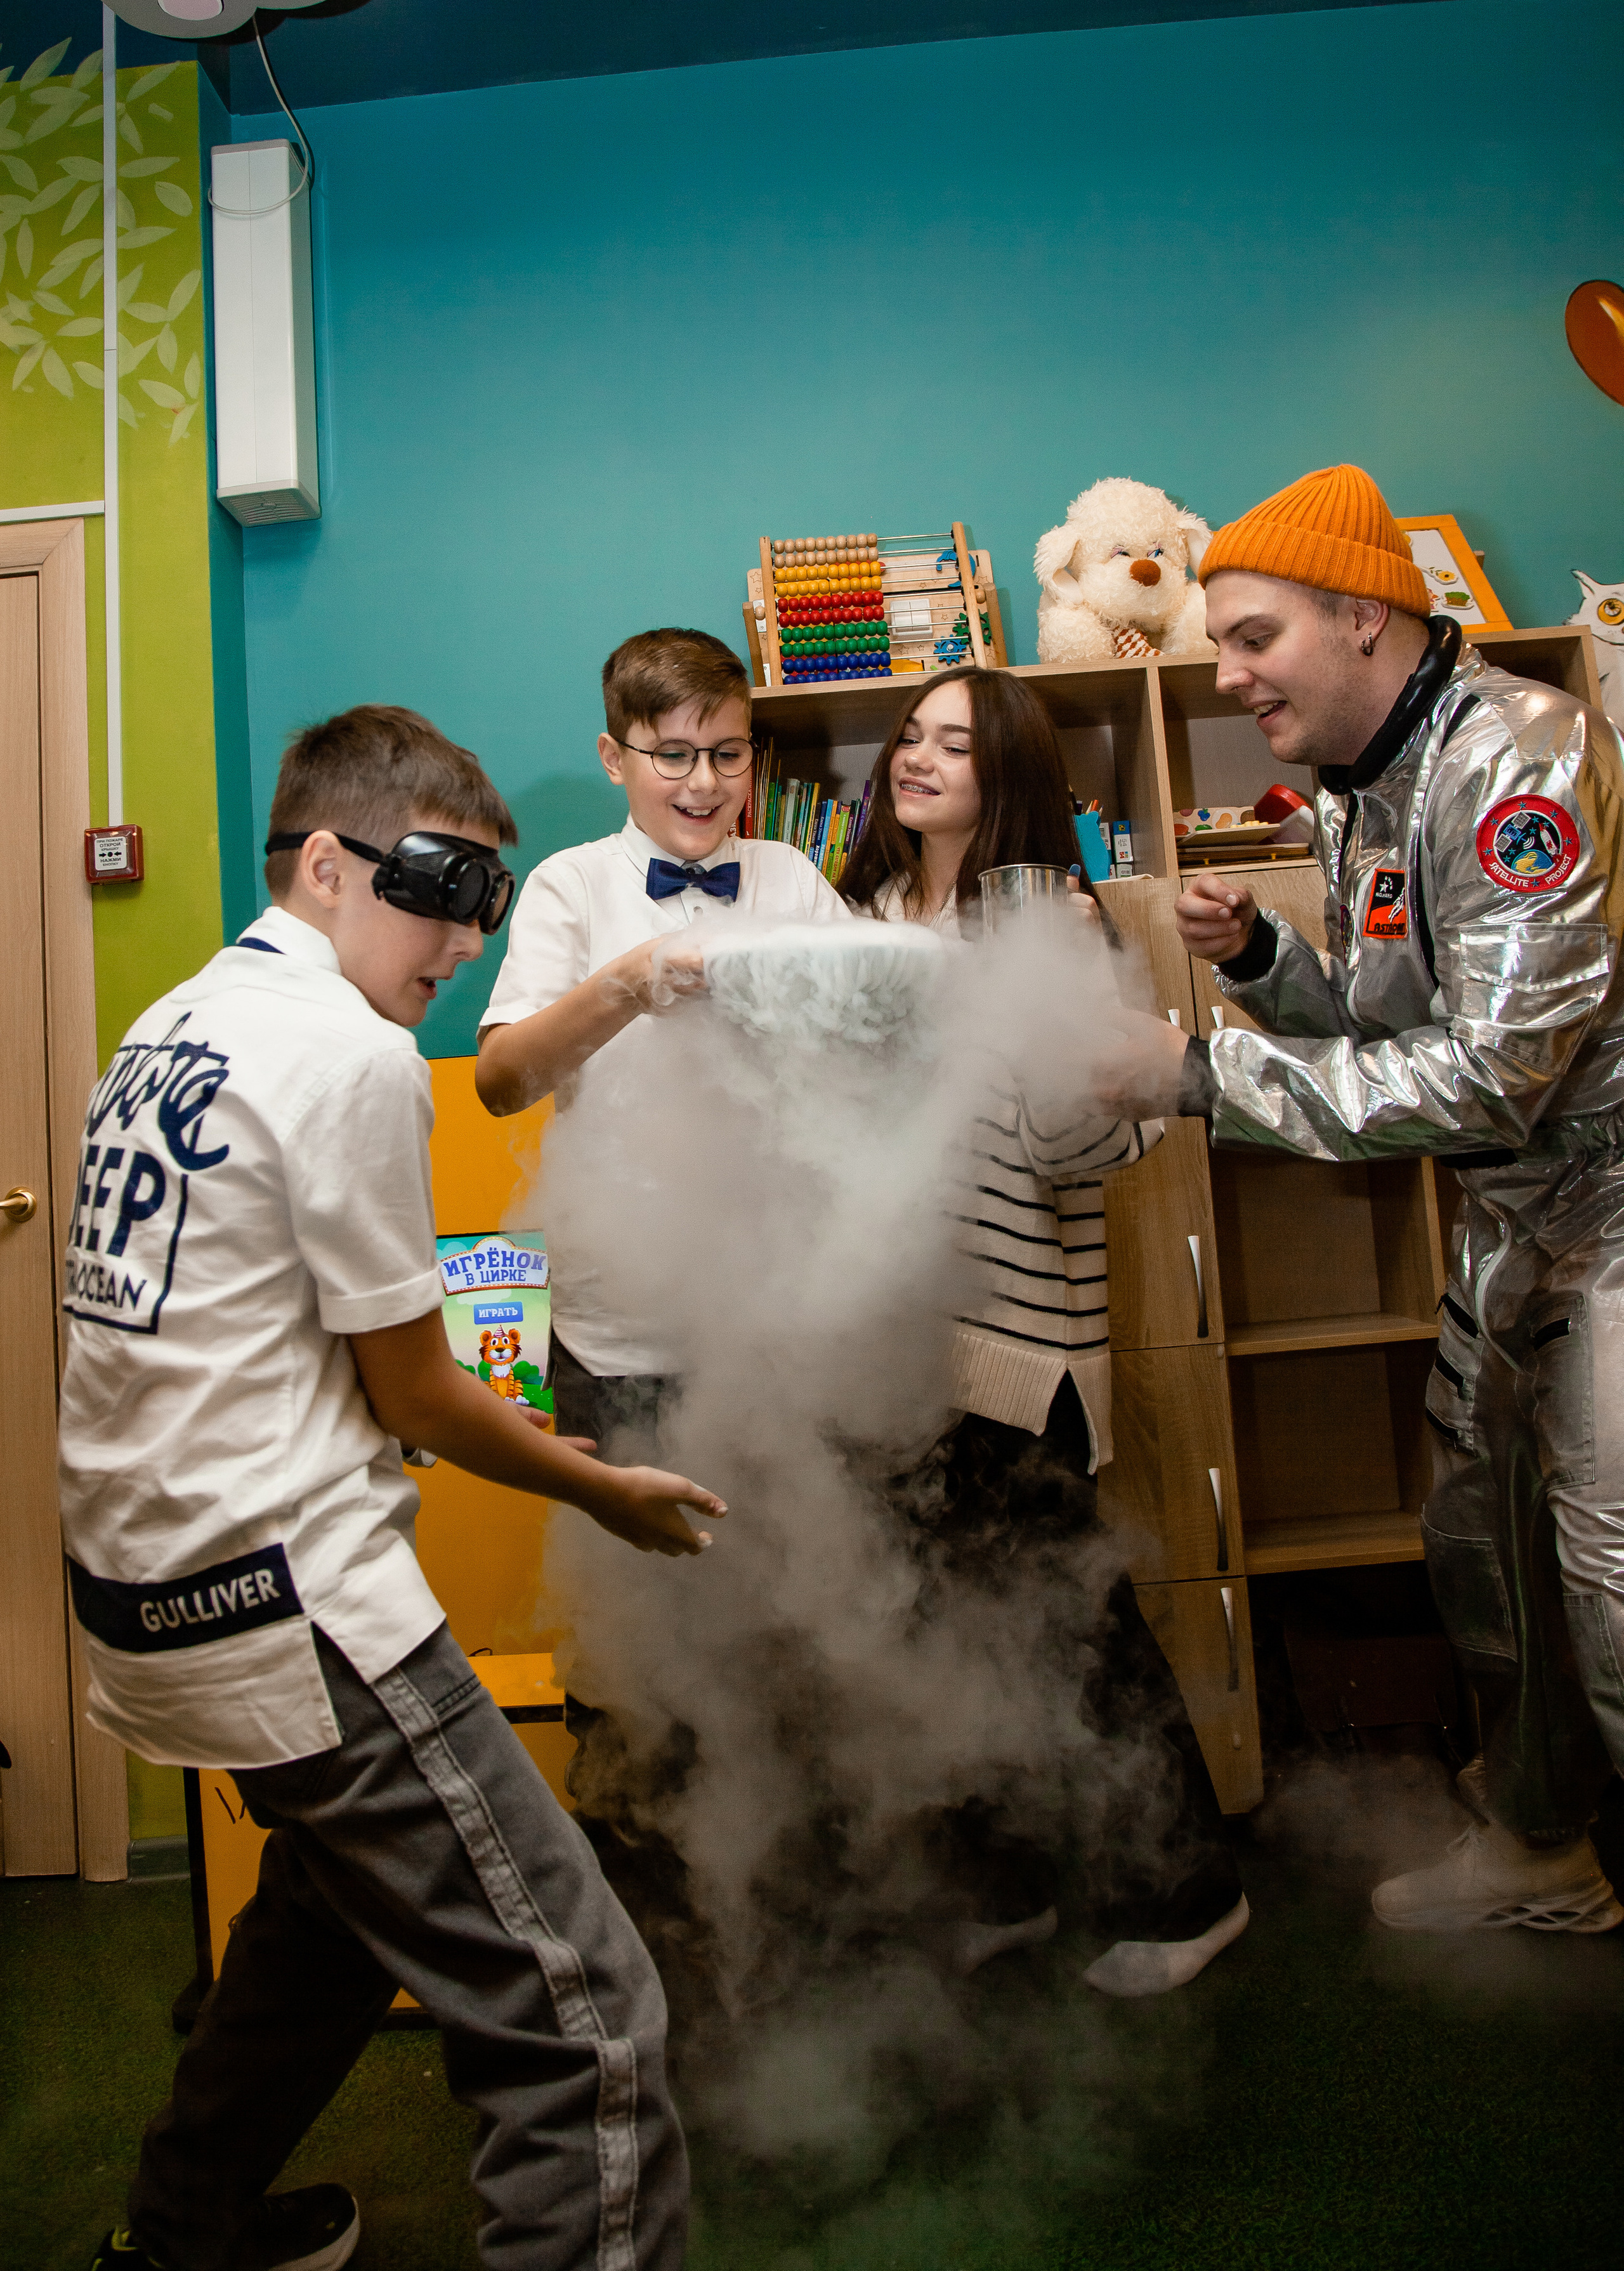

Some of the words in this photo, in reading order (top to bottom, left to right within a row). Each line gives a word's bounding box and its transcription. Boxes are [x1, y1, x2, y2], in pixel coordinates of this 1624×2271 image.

[1489, 862, 1529, 887] SATELLITE
[1545, 854, 1571, 885] PROJECT
[69, 1144, 166, 1257] EEP
[443, 1247, 546, 1277] ИГРЁНОК
[466, 1273, 475, 1285] В
[480, 1269, 526, 1283] ЦИРКЕ
[77, 1262, 147, 1311] OCEAN
[478, 1307, 518, 1318] ИГРАТЬ
[140, 1568, 280, 1632] GULLIVER
